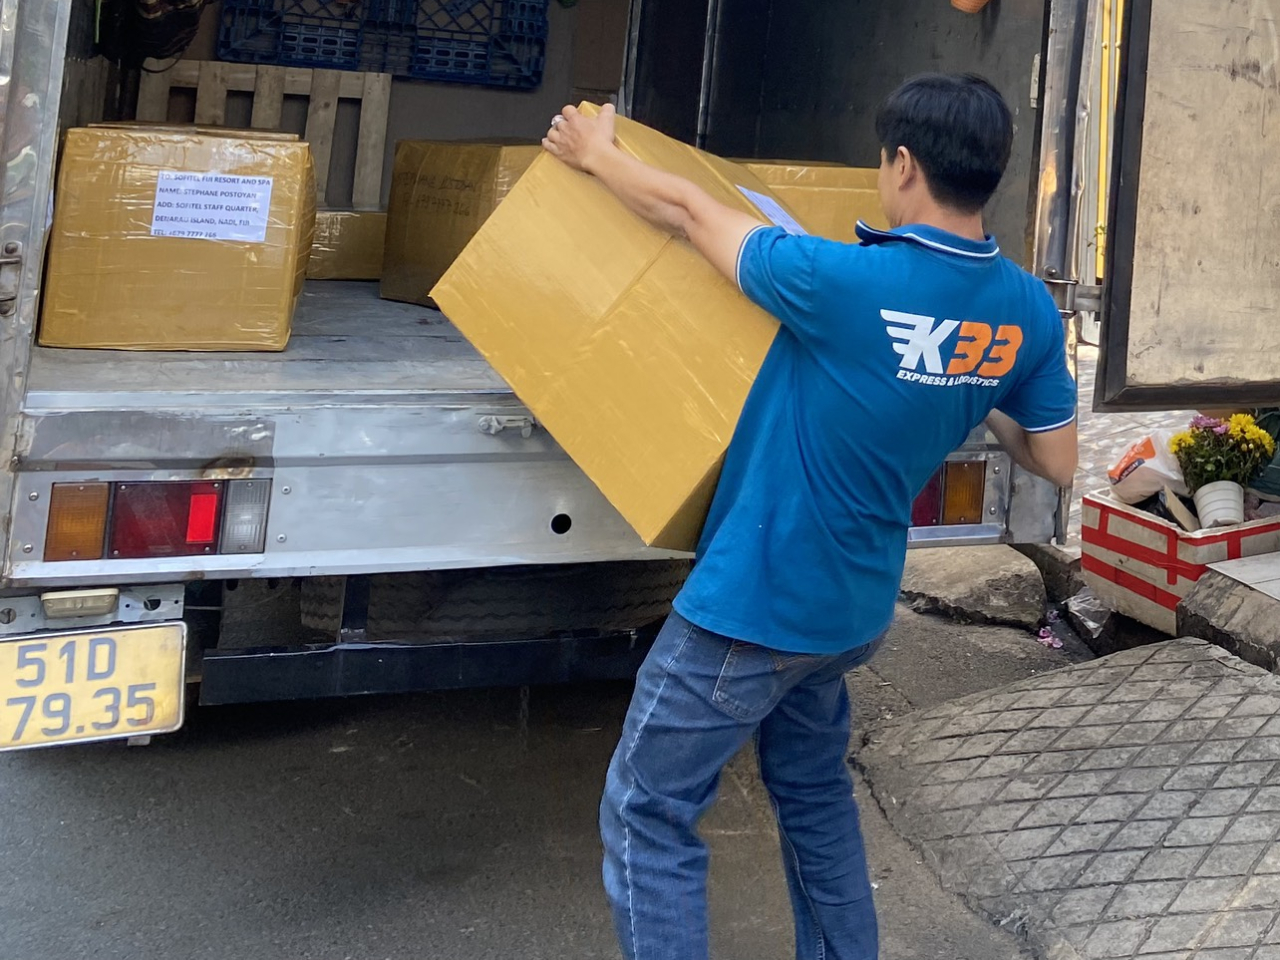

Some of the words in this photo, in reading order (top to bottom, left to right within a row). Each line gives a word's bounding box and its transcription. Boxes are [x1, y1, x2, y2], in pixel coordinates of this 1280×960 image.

[183, 189, 219, 197] STEPHANE
[219, 190, 257, 198] POSTOYAN
[157, 201, 174, 209] ADD:
[175, 202, 202, 210] SOFITEL
[203, 203, 224, 211] STAFF
[225, 205, 259, 213] QUARTER,
[896, 370, 947, 387] EXPRESS
[954, 375, 1000, 387] LOGISTICS
[15, 637, 117, 688] 51D
[6, 683, 157, 742] 79.35
